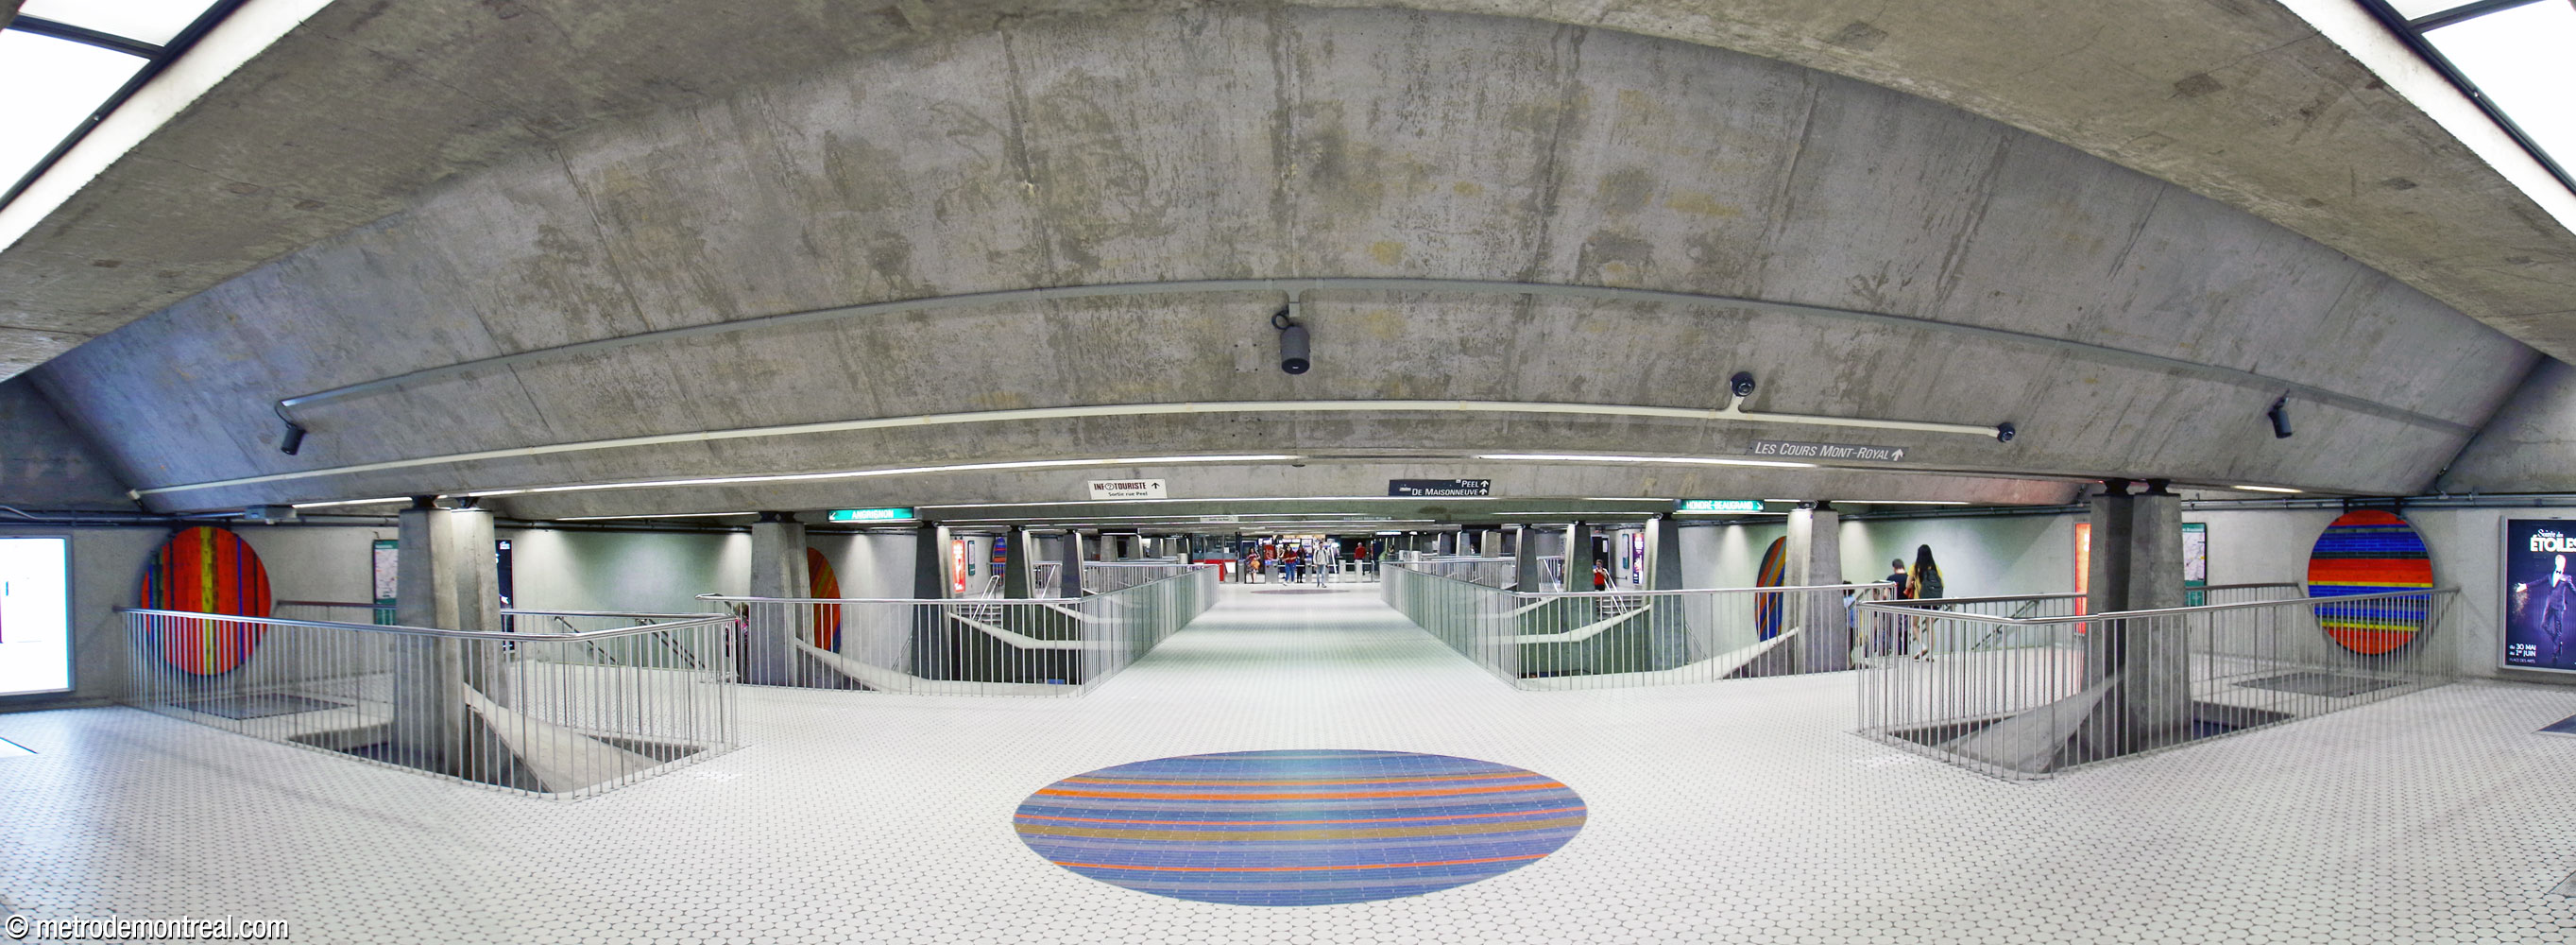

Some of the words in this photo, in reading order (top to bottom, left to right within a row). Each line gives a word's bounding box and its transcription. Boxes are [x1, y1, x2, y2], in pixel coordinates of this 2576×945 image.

[1754, 441, 1777, 455] LES
[1779, 442, 1817, 456] COURS
[1819, 445, 1889, 460] MONT-ROYAL
[1411, 488, 1423, 496] DE
[1424, 488, 1478, 496] MAISONNEUVE
[851, 509, 895, 520] ANGRIGNON
